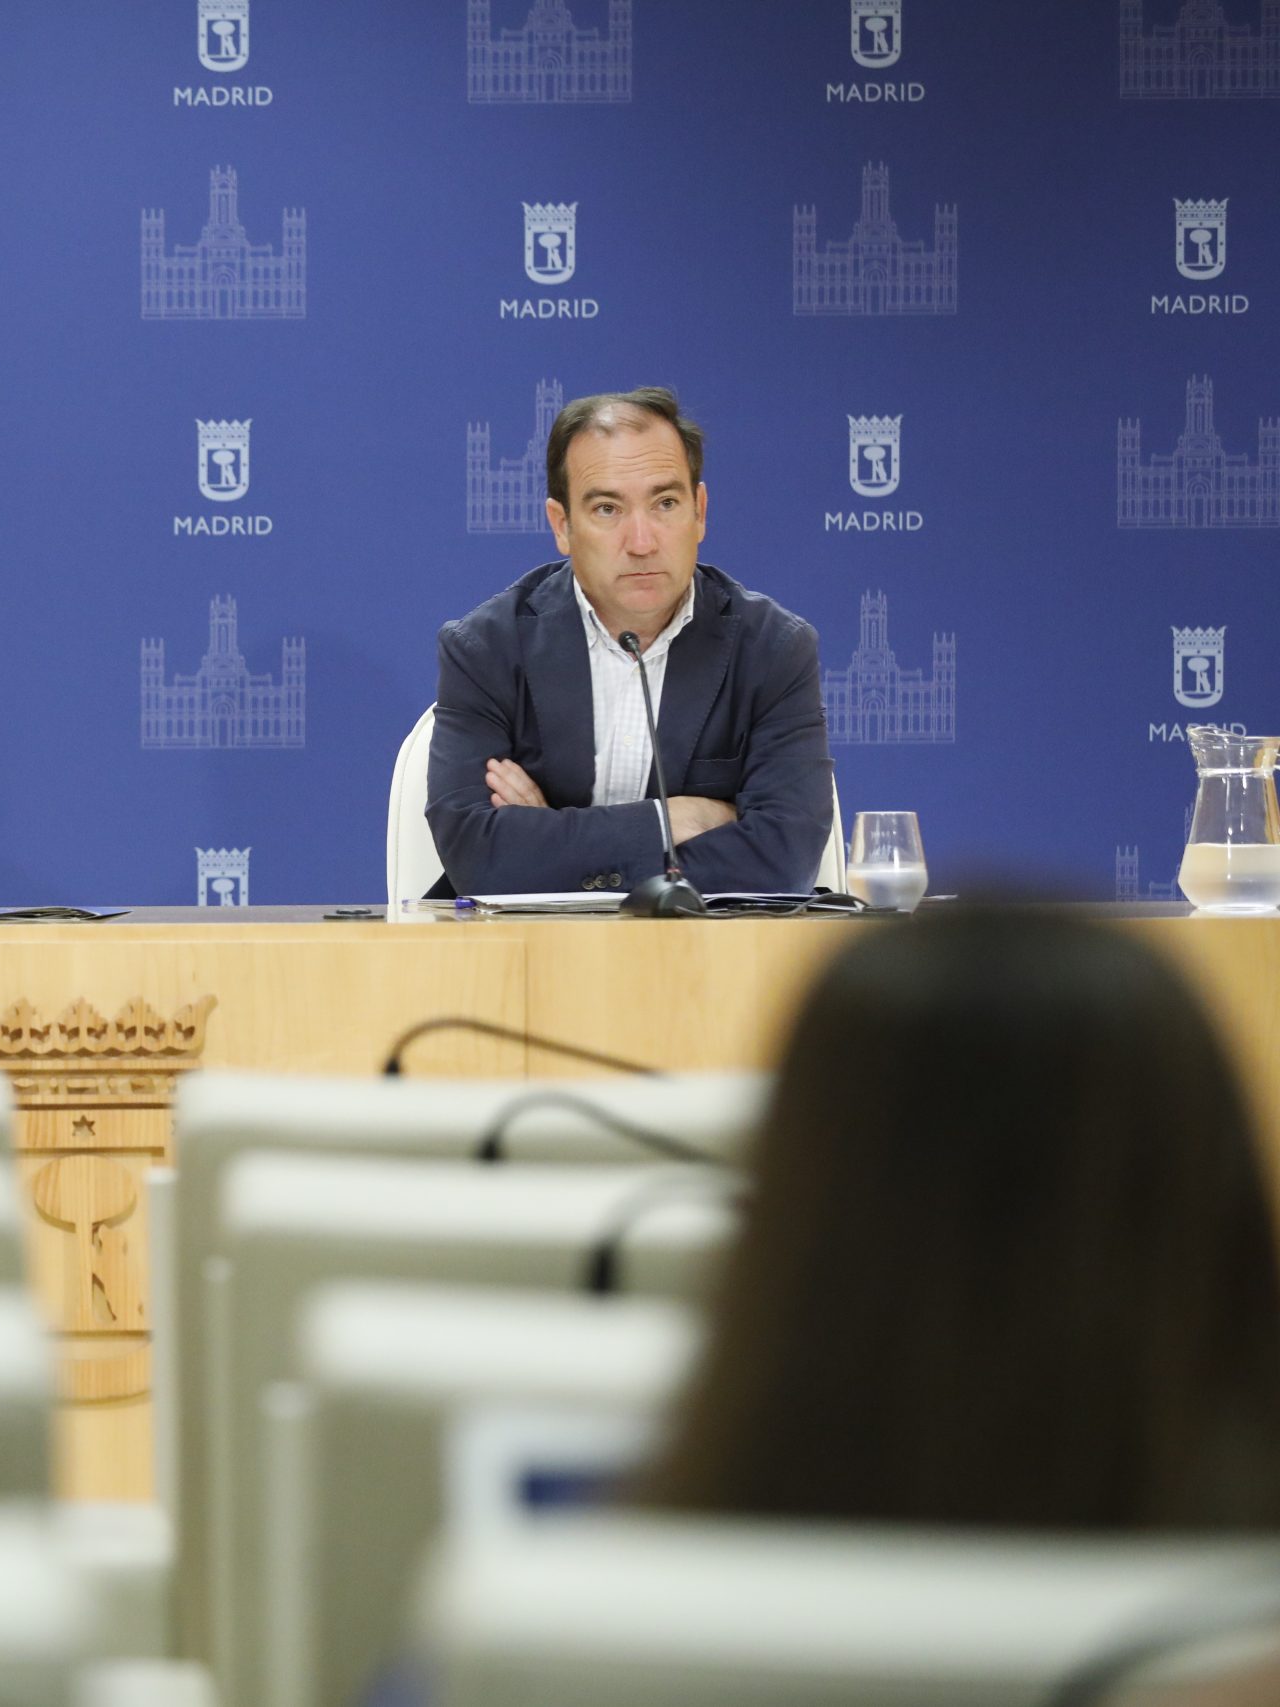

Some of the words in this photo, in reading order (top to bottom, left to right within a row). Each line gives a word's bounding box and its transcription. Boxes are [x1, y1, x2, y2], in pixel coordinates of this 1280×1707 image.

[173, 86, 273, 106] MADRID
[826, 82, 925, 102] MADRID
[499, 298, 599, 319] MADRID
[1151, 294, 1250, 315] MADRID
[173, 515, 273, 536] MADRID
[824, 511, 924, 532] MADRID
